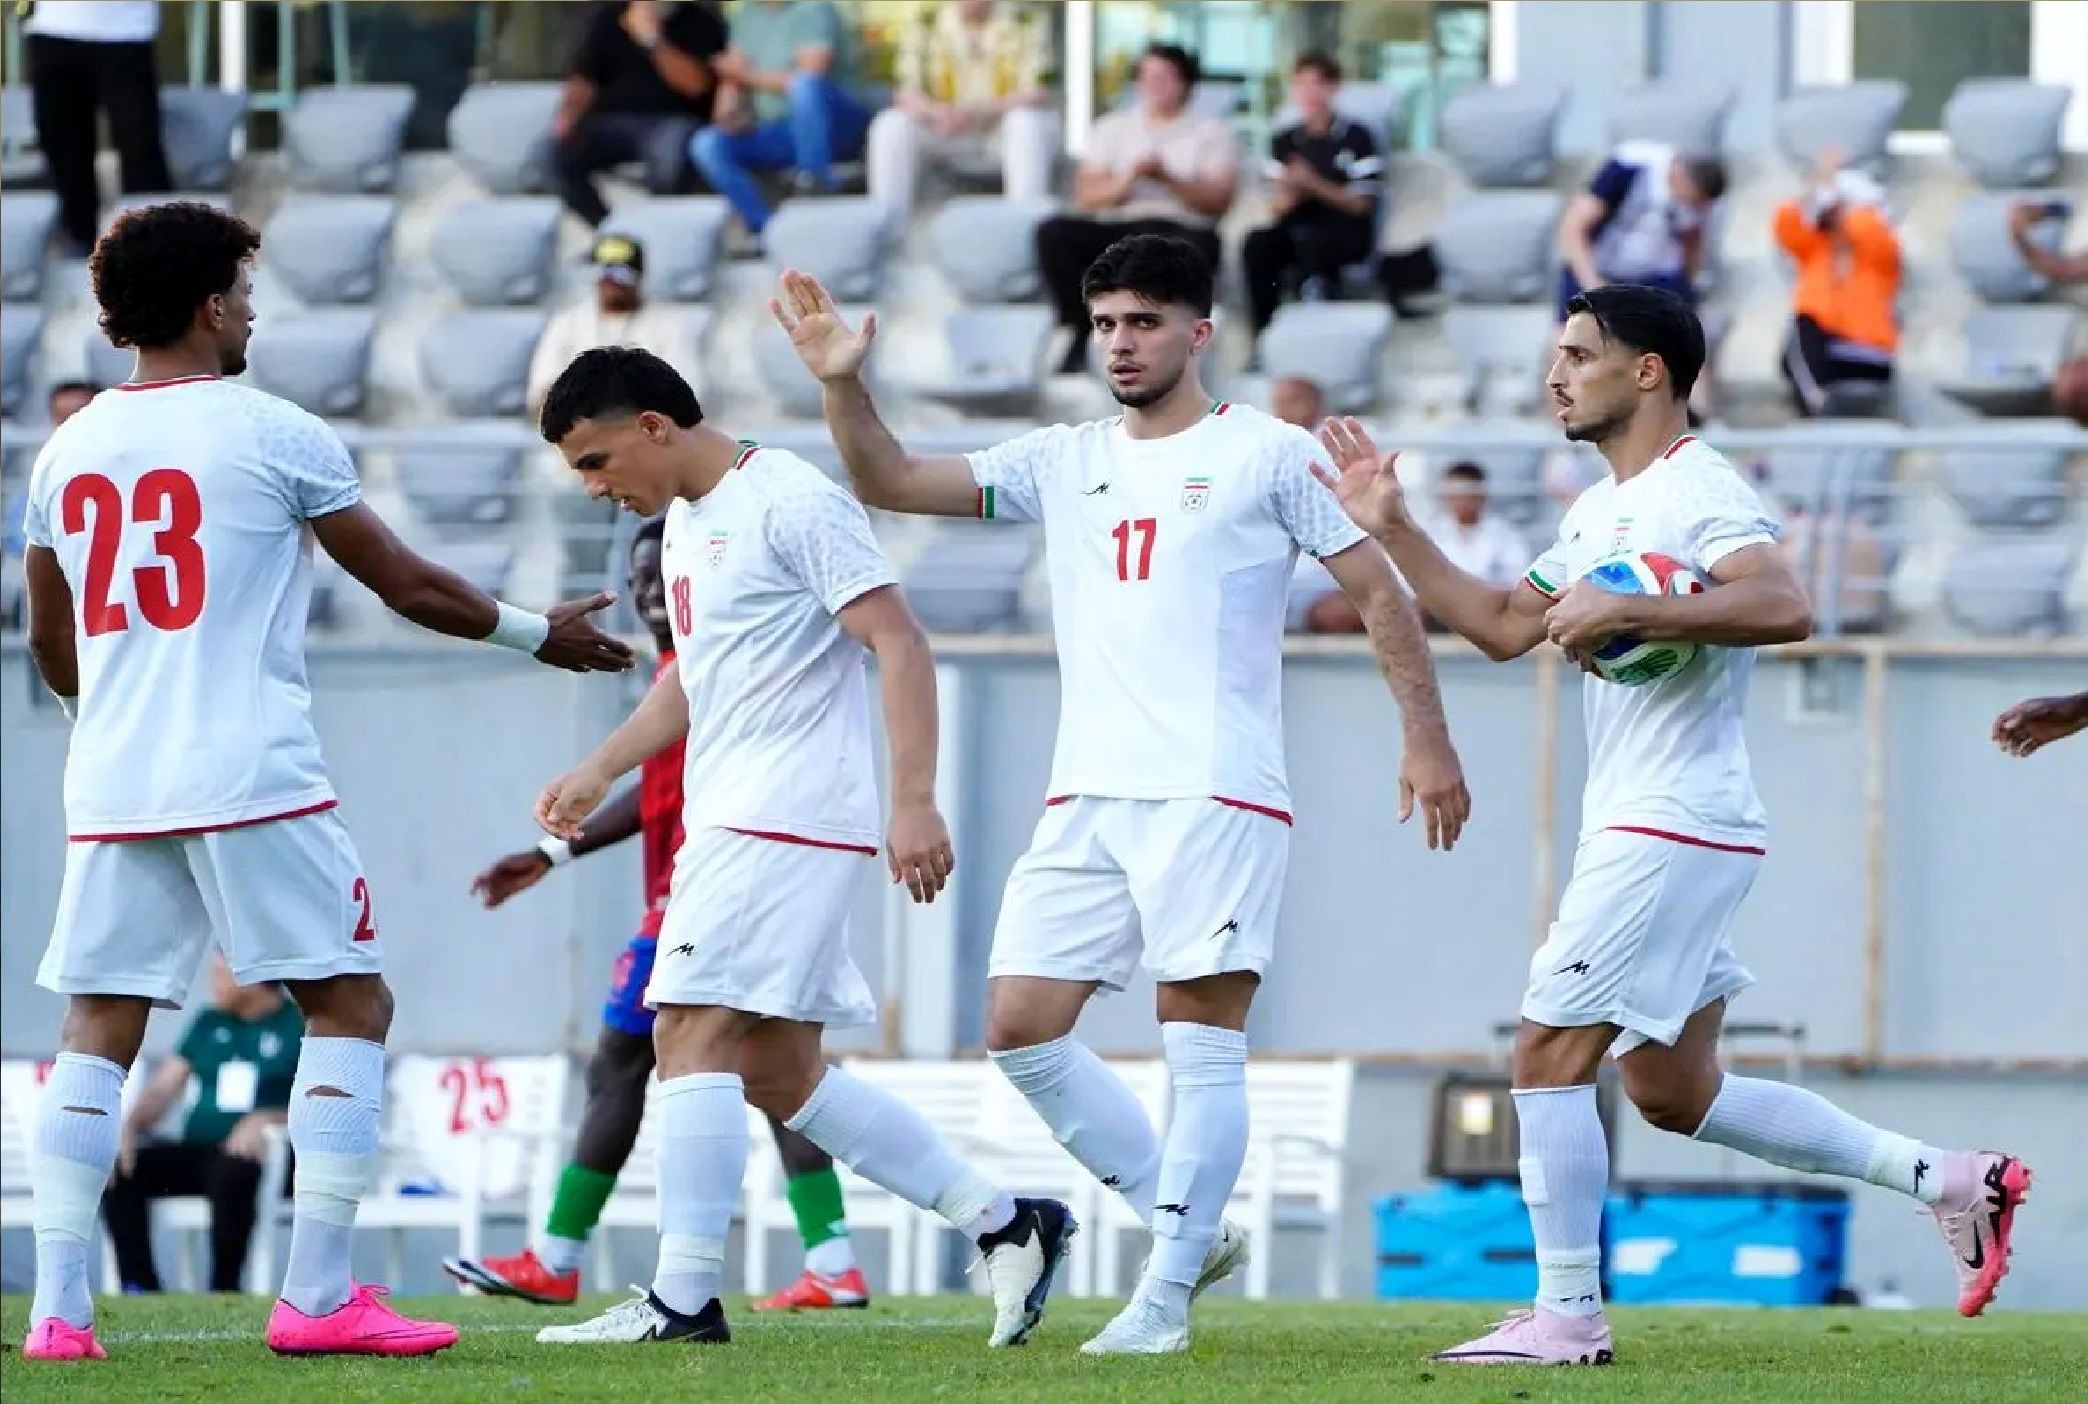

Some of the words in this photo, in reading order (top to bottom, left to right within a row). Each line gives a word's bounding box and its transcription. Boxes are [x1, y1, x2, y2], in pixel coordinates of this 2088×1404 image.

[62, 468, 206, 637] 23
[1112, 517, 1157, 581] 17
[671, 574, 692, 636] 18
[438, 1055, 510, 1134] 25
